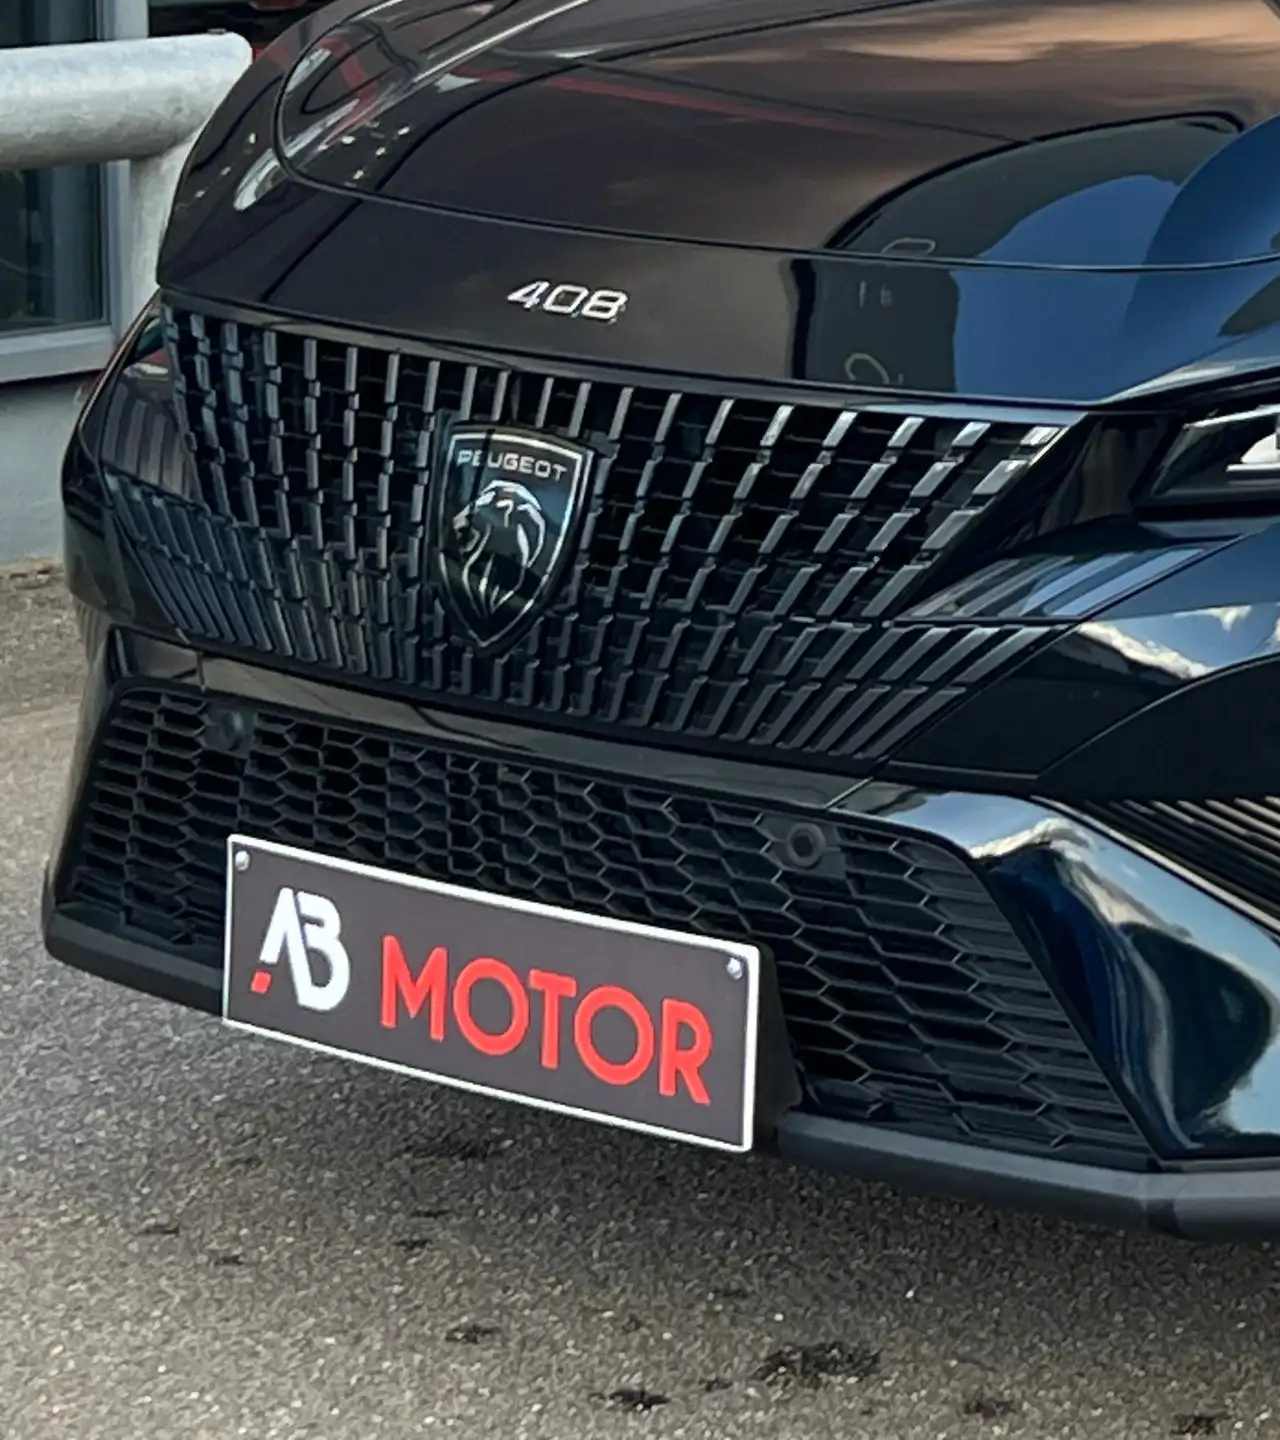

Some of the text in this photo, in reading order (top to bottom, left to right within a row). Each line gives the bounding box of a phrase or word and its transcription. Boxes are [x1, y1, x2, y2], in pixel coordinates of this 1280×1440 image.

[507, 280, 628, 320] 408
[456, 448, 567, 482] PEUGEOT
[251, 887, 712, 1106] AB MOTOR
